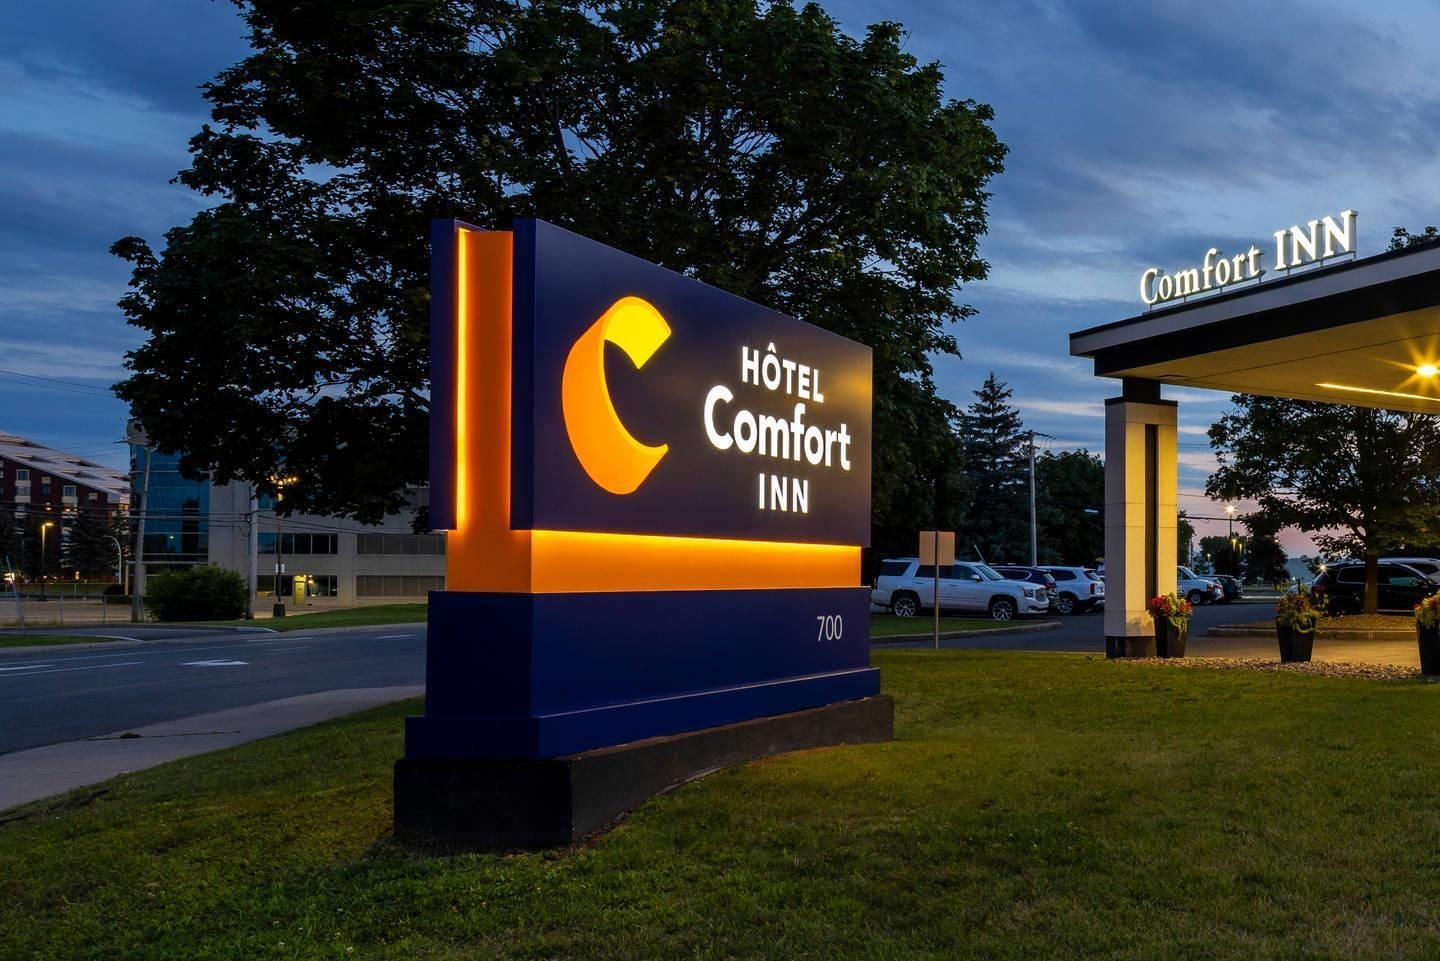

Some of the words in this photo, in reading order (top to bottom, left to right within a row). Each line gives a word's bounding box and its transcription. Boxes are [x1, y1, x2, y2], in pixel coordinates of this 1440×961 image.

[1140, 244, 1265, 305] Comfort
[1274, 209, 1359, 271] INN
[741, 342, 825, 404] HÔTEL
[703, 384, 851, 471] Comfort
[758, 472, 809, 514] INN
[816, 614, 843, 642] 700
